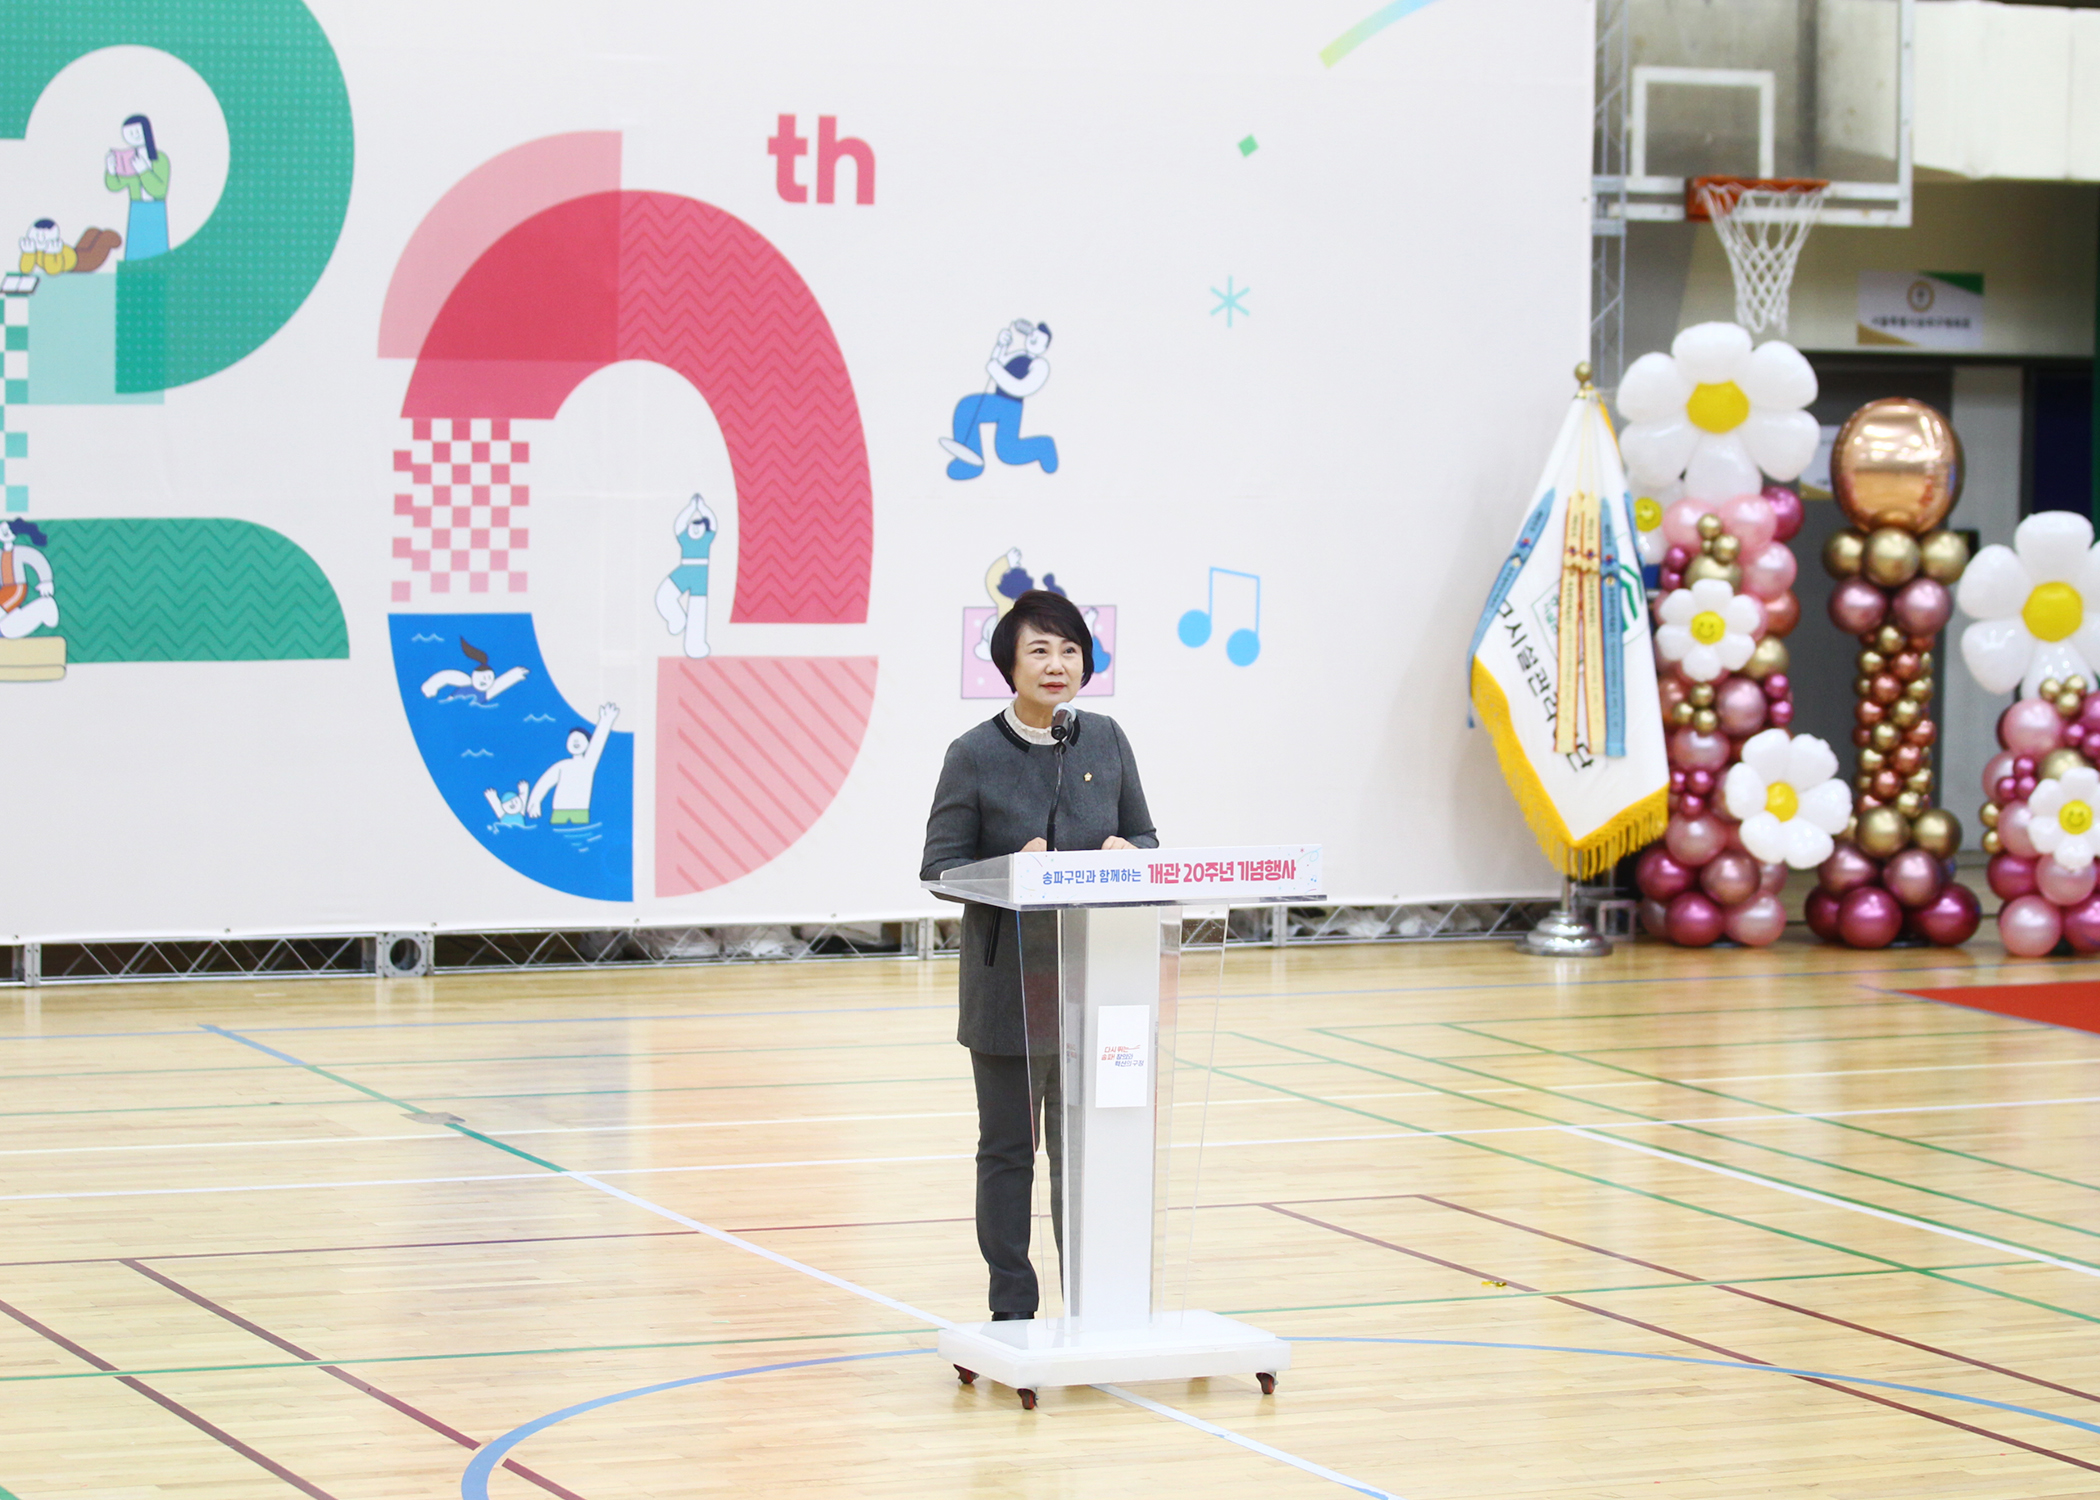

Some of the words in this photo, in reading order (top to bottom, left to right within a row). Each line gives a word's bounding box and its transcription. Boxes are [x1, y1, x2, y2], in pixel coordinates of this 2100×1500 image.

[1042, 869, 1096, 885] 송파구민과
[1099, 869, 1142, 883] 함께하는
[1147, 863, 1181, 884] 개관
[1183, 861, 1235, 883] 20주년
[1237, 859, 1296, 881] 기념행사
